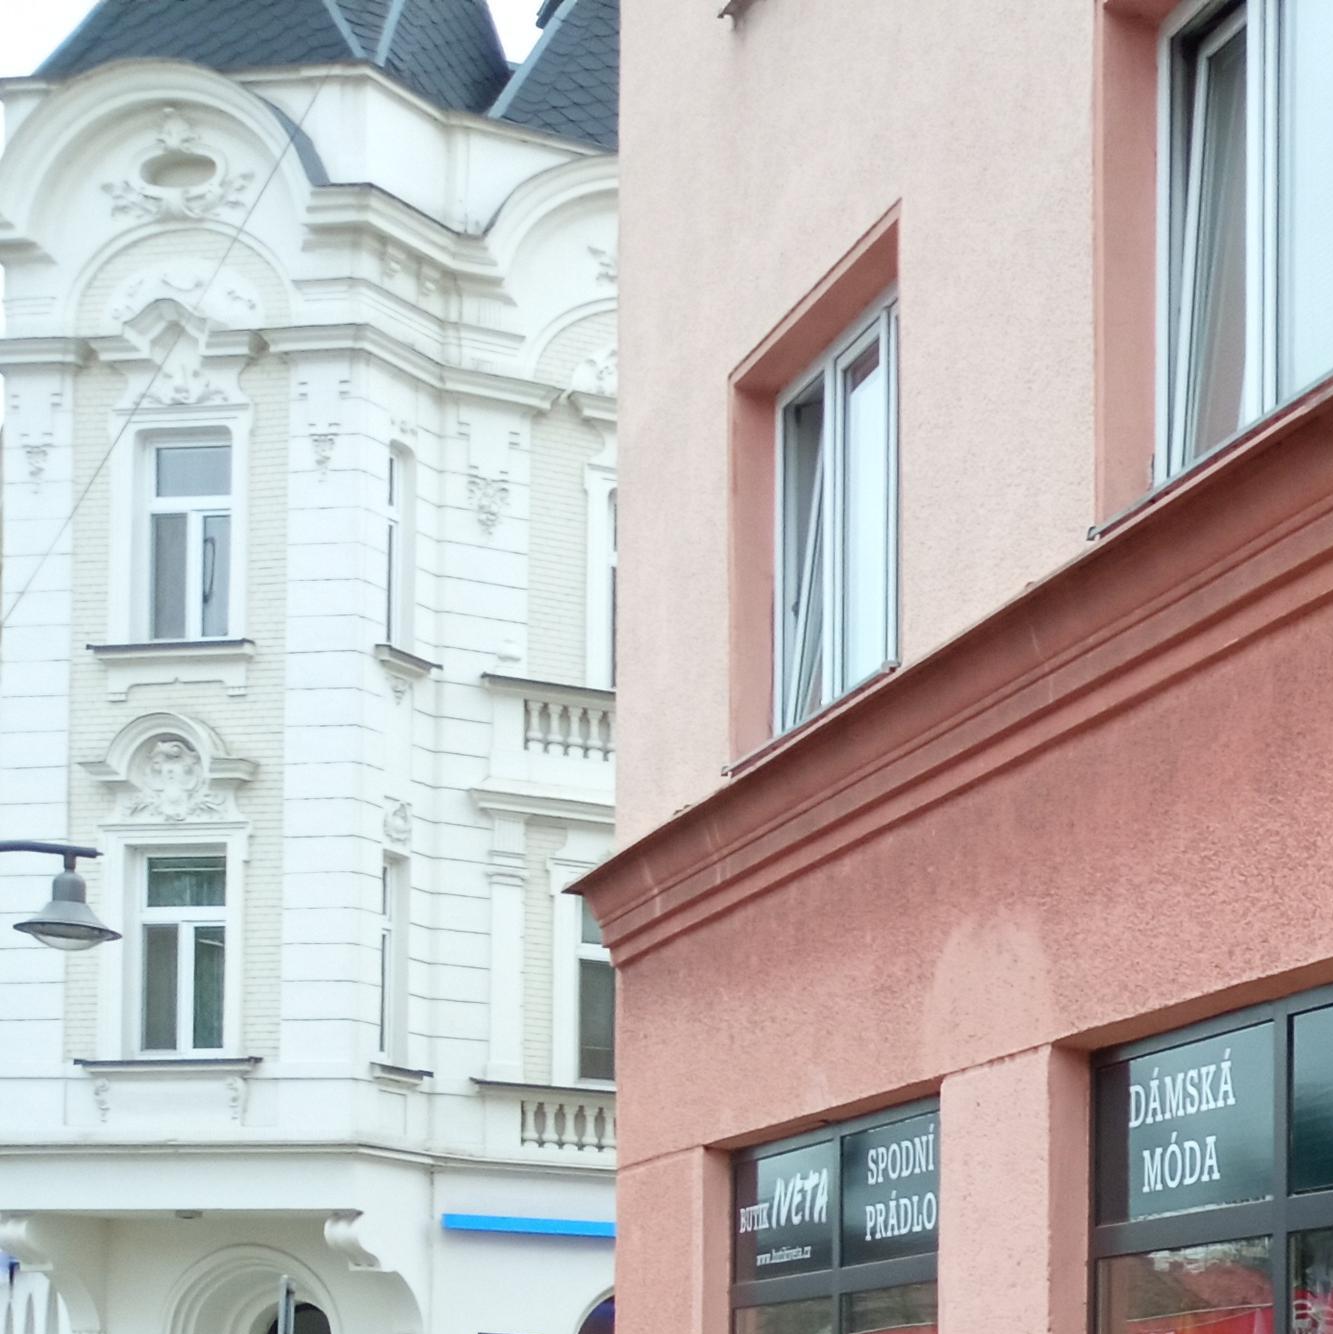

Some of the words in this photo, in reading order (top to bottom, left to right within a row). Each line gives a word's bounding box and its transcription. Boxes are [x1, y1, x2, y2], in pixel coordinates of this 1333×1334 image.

[1128, 1047, 1236, 1128] DÁMSKÁ
[867, 1123, 935, 1185] SPODNÍ
[1142, 1131, 1221, 1193] MÓDA
[739, 1202, 770, 1234] BUTIK
[770, 1168, 829, 1230] IVETA
[864, 1190, 938, 1241] PRÁDLO
